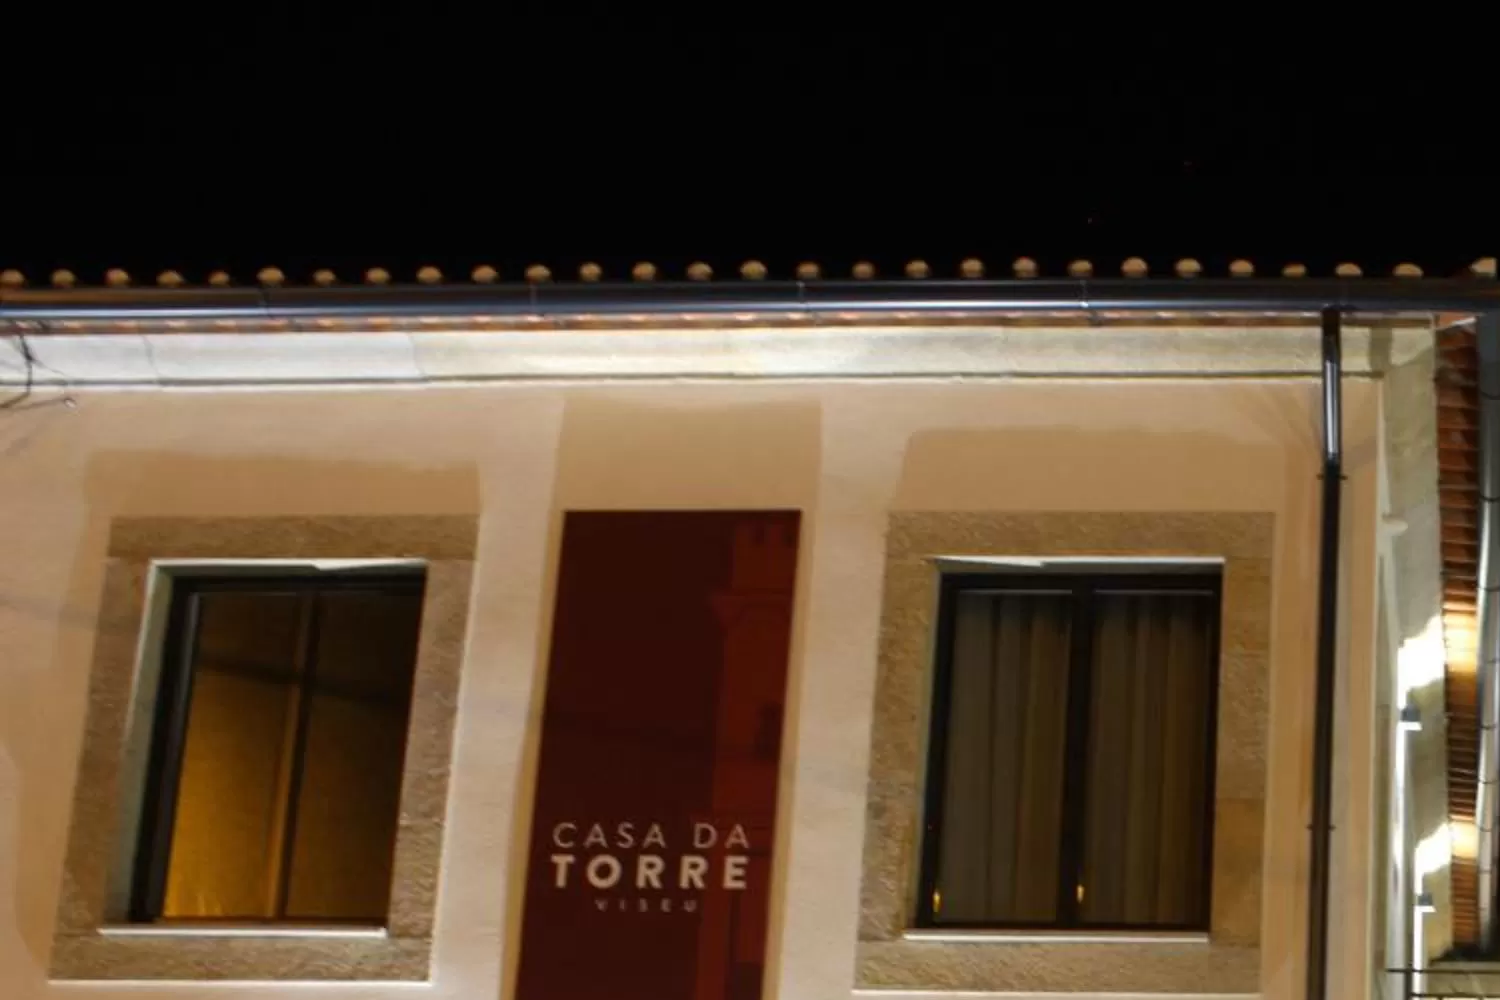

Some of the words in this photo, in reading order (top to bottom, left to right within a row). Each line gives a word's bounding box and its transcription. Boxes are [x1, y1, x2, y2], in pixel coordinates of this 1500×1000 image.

[552, 822, 666, 848] CASA
[693, 823, 749, 848] DA
[551, 855, 748, 889] TORRE
[595, 898, 697, 912] VISEU
